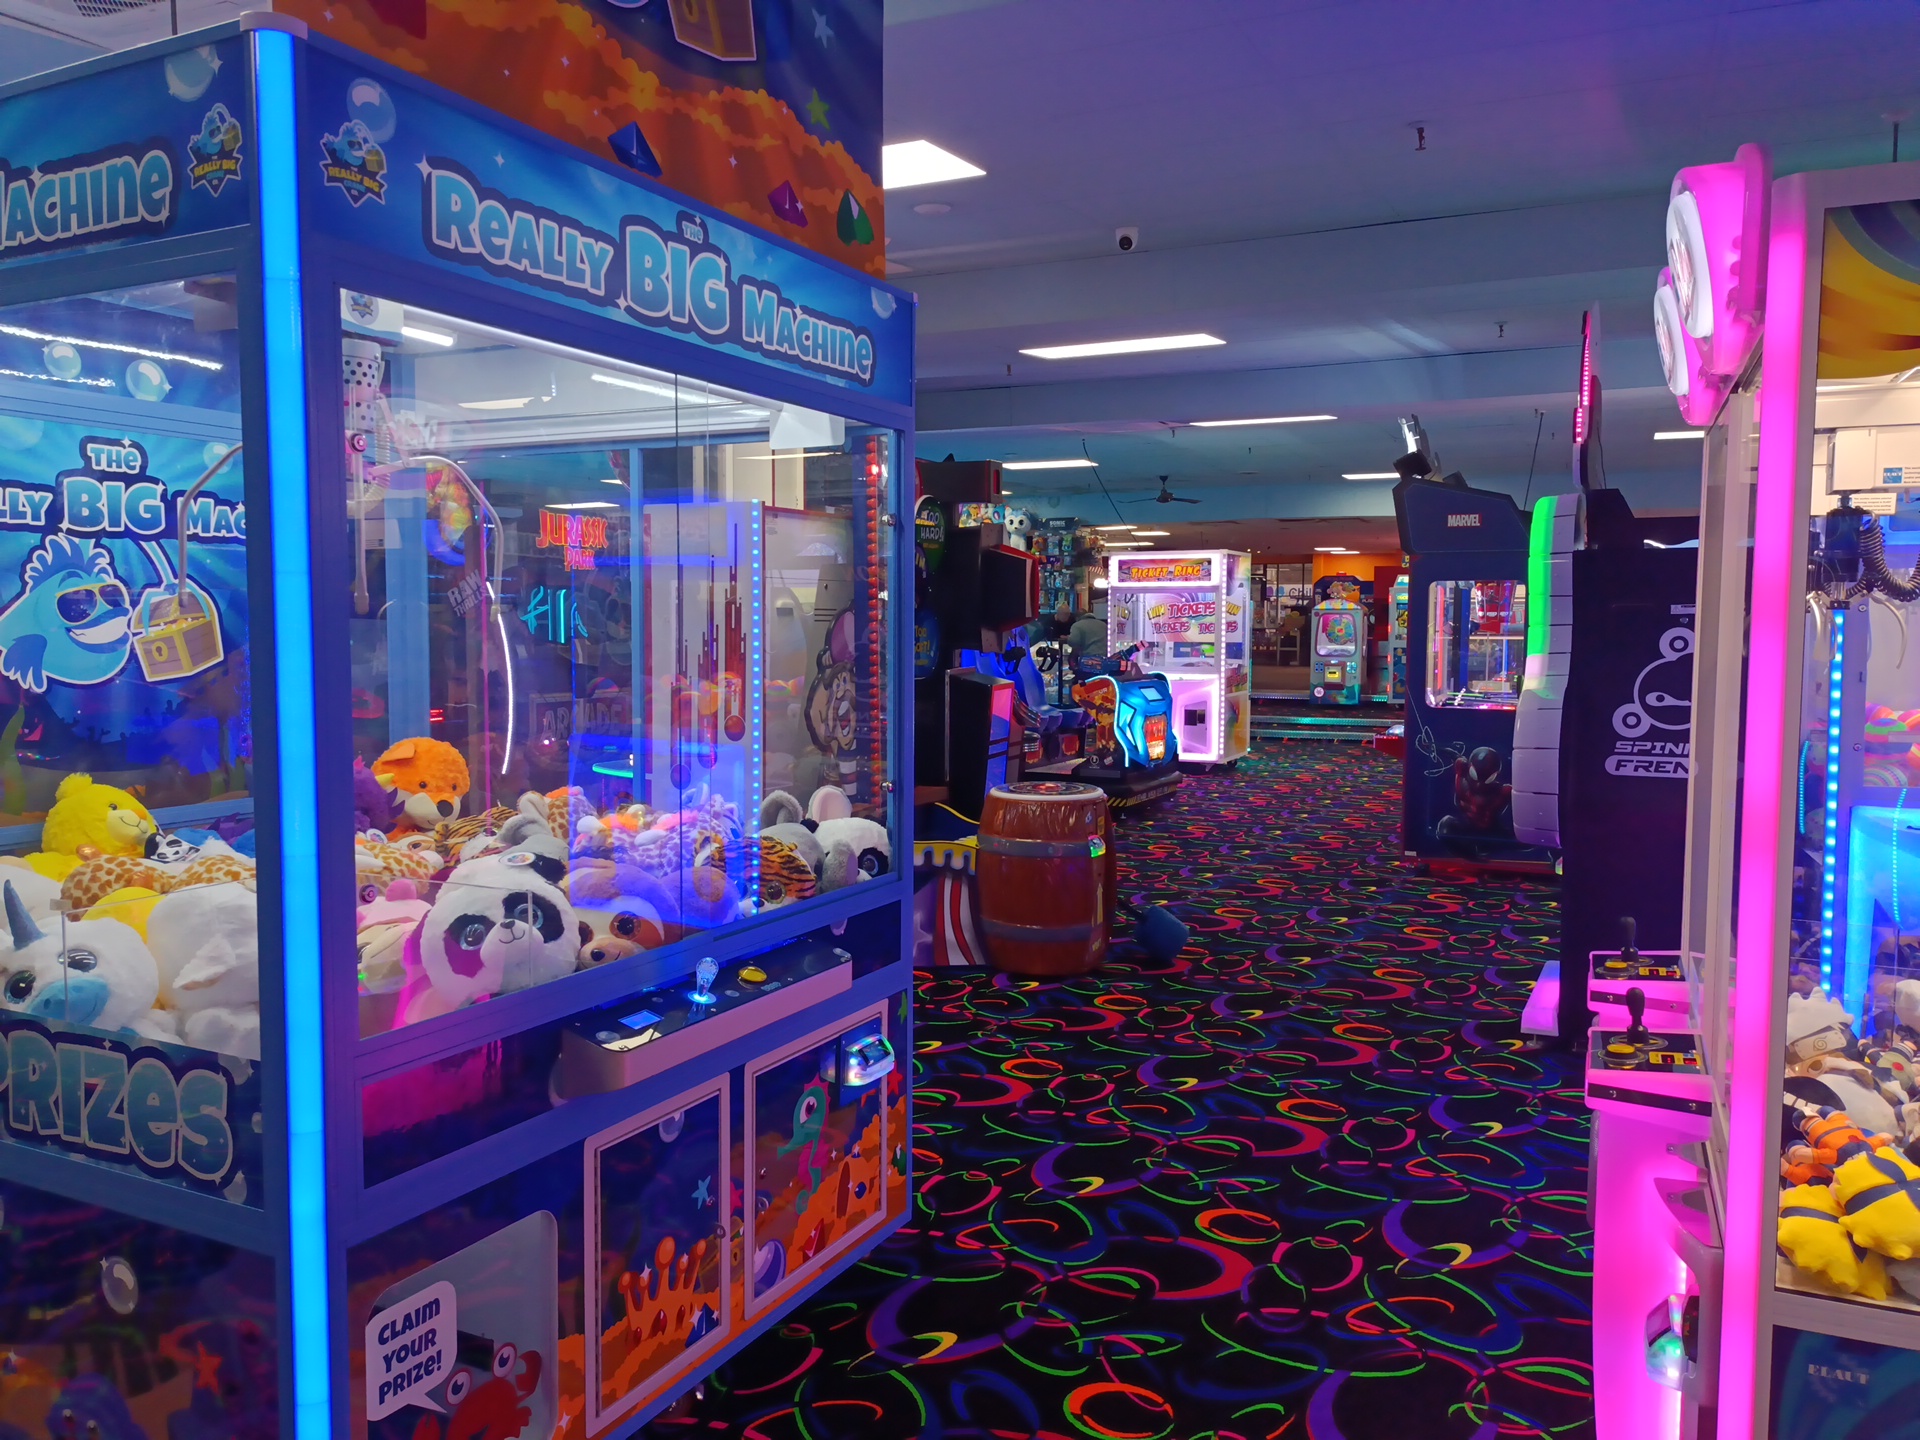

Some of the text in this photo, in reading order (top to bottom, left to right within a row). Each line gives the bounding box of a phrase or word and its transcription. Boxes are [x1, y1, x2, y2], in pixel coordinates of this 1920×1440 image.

[626, 225, 730, 335] BIG
[63, 476, 166, 535] BIG
[1447, 513, 1481, 527] MARVEL
[535, 508, 609, 549] JURASSIC
[564, 546, 596, 571] PARK
[1131, 564, 1202, 578] TICKET RING
[447, 569, 483, 607] RAW
[1168, 601, 1216, 619] TICKETS
[1153, 621, 1191, 635] TICKETS
[540, 702, 623, 739] ARADE
[383, 1328, 437, 1374] YOUR
[1808, 1364, 1869, 1385] ELAUT
